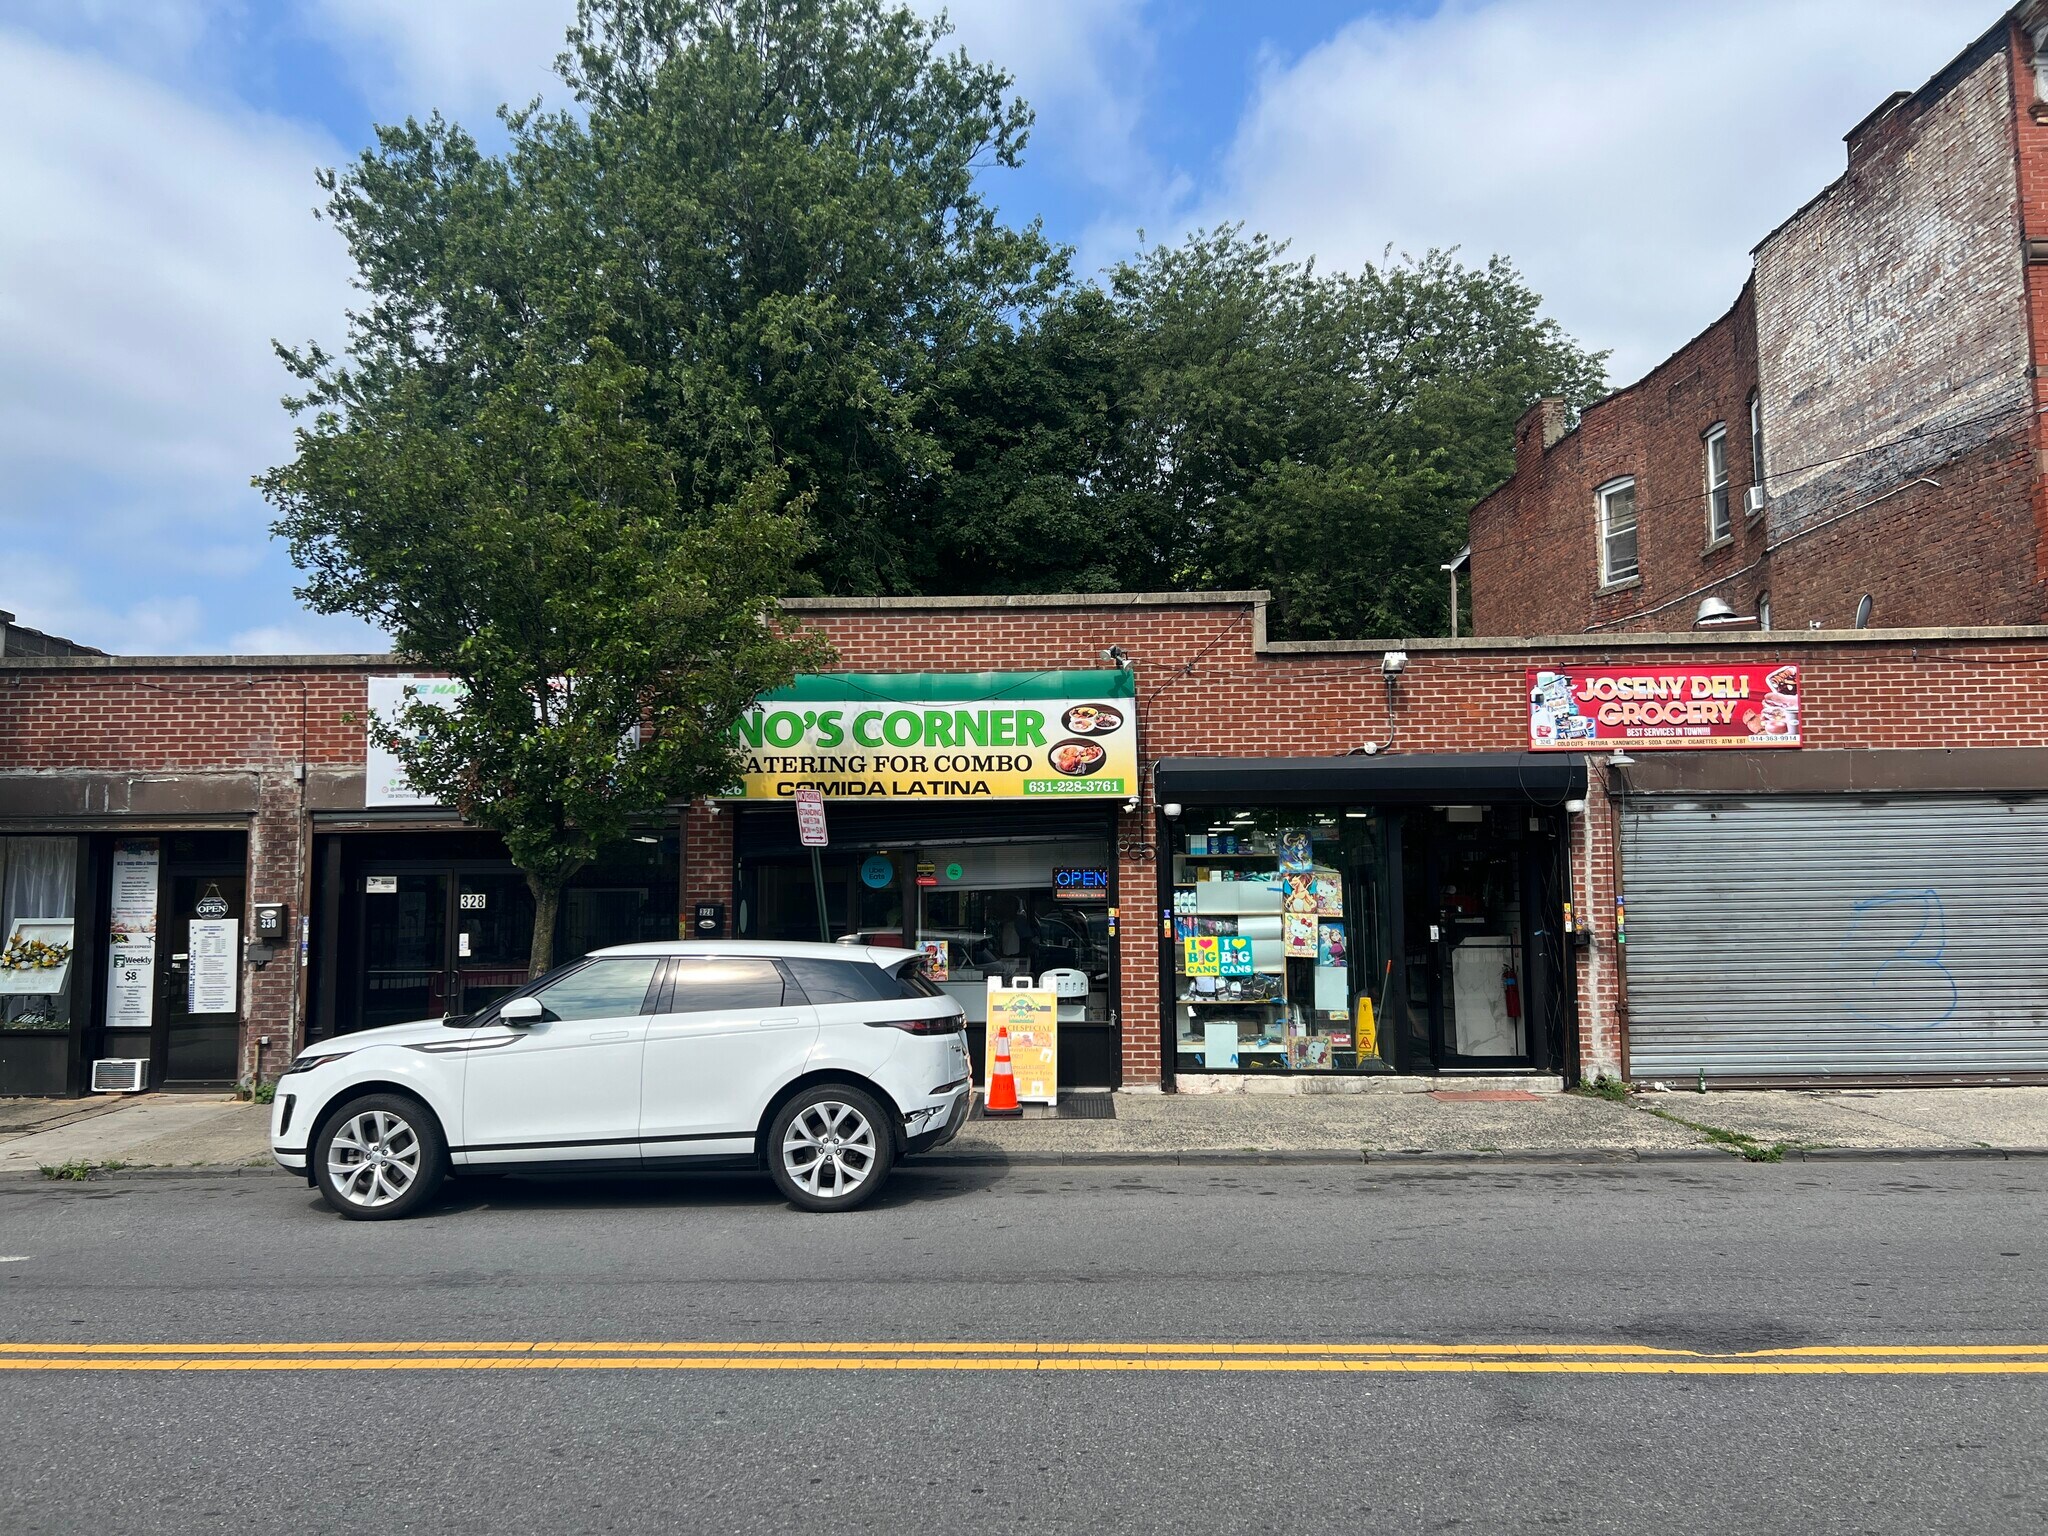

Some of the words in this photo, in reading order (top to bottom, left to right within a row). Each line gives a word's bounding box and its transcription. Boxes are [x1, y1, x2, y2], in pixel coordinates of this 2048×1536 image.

[1576, 676, 1686, 701] JOSENY
[1690, 674, 1750, 700] DELI
[1598, 700, 1738, 726] GROCERY
[729, 710, 844, 748] NO'S
[852, 710, 1048, 748] CORNER
[1626, 728, 1642, 737] BEST
[1643, 728, 1674, 737] SERVICES
[1676, 727, 1682, 736] IN
[746, 756, 867, 774] ATERING
[873, 755, 928, 772] FOR
[934, 754, 1032, 772] COMBO
[777, 781, 887, 796] COMIDA
[892, 780, 991, 795] LATINA
[1028, 781, 1118, 792] 631-228-3761
[797, 791, 806, 801] NO
[1057, 872, 1106, 886] OPEN
[462, 895, 484, 908] 328
[261, 919, 277, 928] 330
[1190, 940, 1196, 950] I
[1224, 939, 1230, 950] I
[126, 956, 152, 965] Weekly
[1221, 965, 1251, 973] CANS
[125, 971, 137, 981] $8
